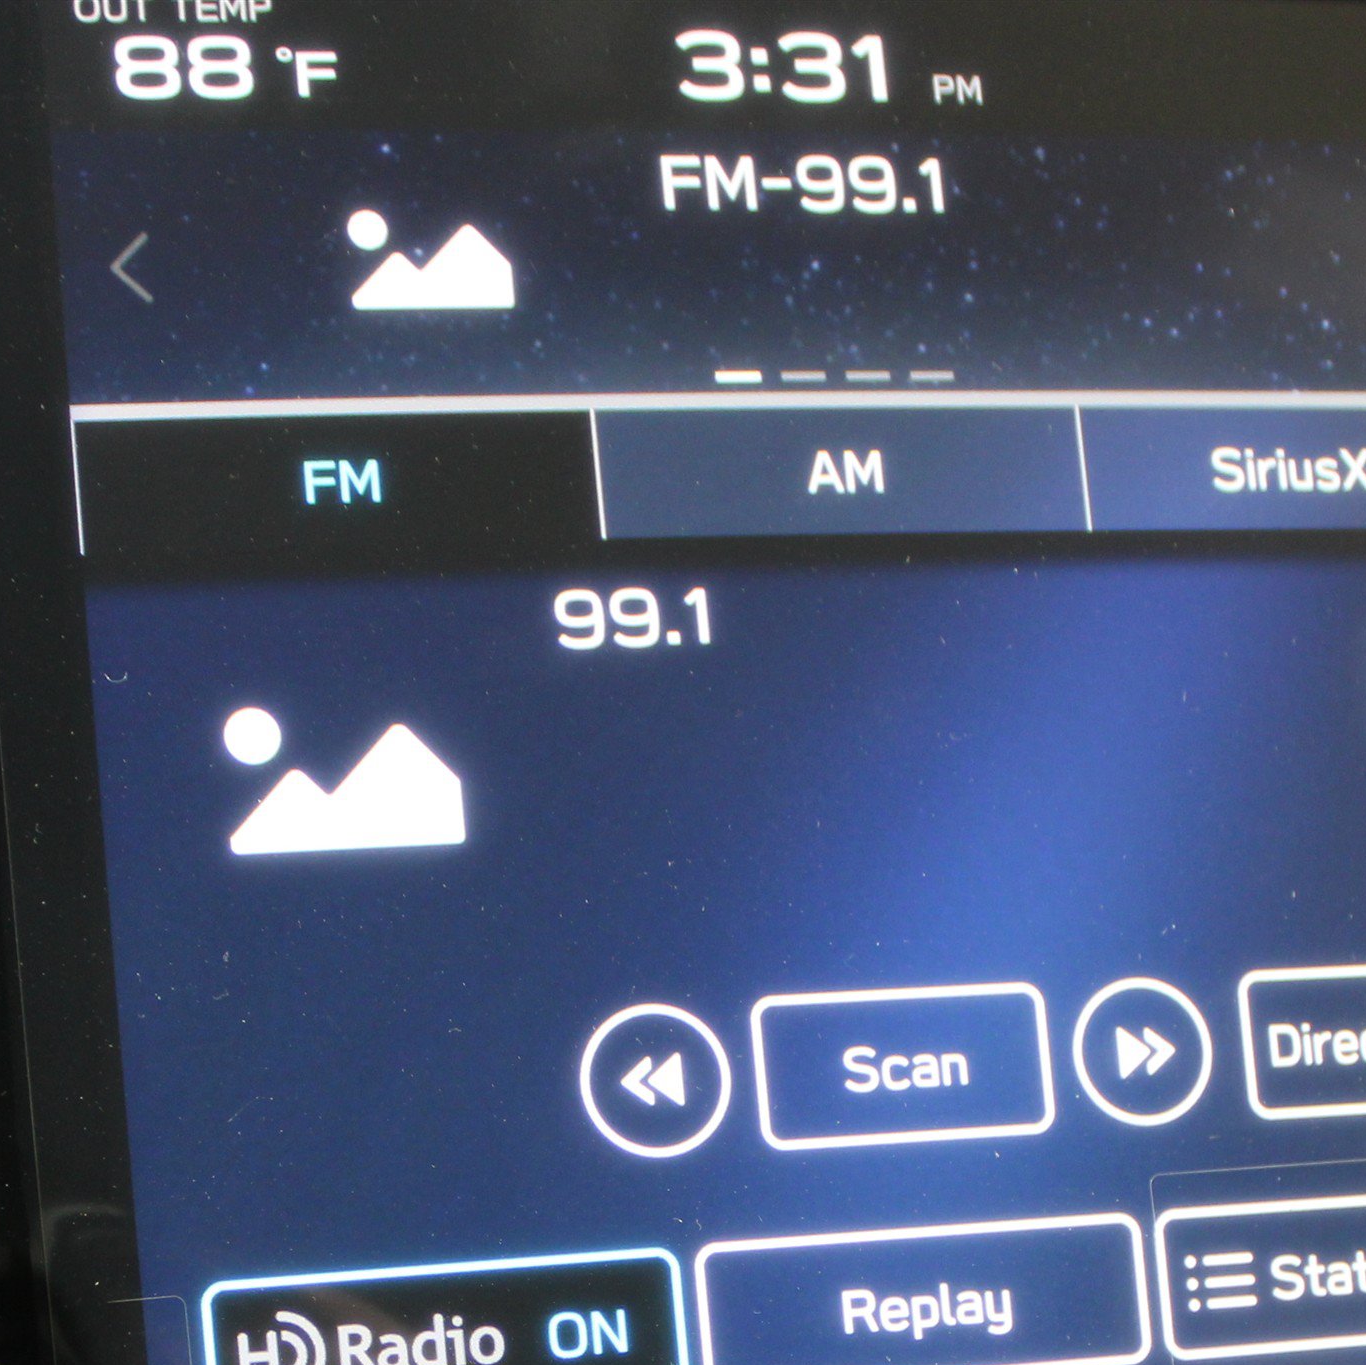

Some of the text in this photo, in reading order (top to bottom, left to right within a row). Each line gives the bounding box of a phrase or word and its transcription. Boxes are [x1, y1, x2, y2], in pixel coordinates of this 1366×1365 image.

[176, 0, 273, 23] TEMP
[114, 35, 254, 100] 88
[674, 29, 984, 106] 3:31 PM
[659, 153, 947, 214] FM-99.1
[302, 459, 382, 505] FM
[807, 450, 885, 494] AM
[554, 586, 711, 650] 99.1
[843, 1045, 969, 1094] Scan
[548, 1309, 628, 1360] ON
[842, 1284, 1012, 1340] Replay
